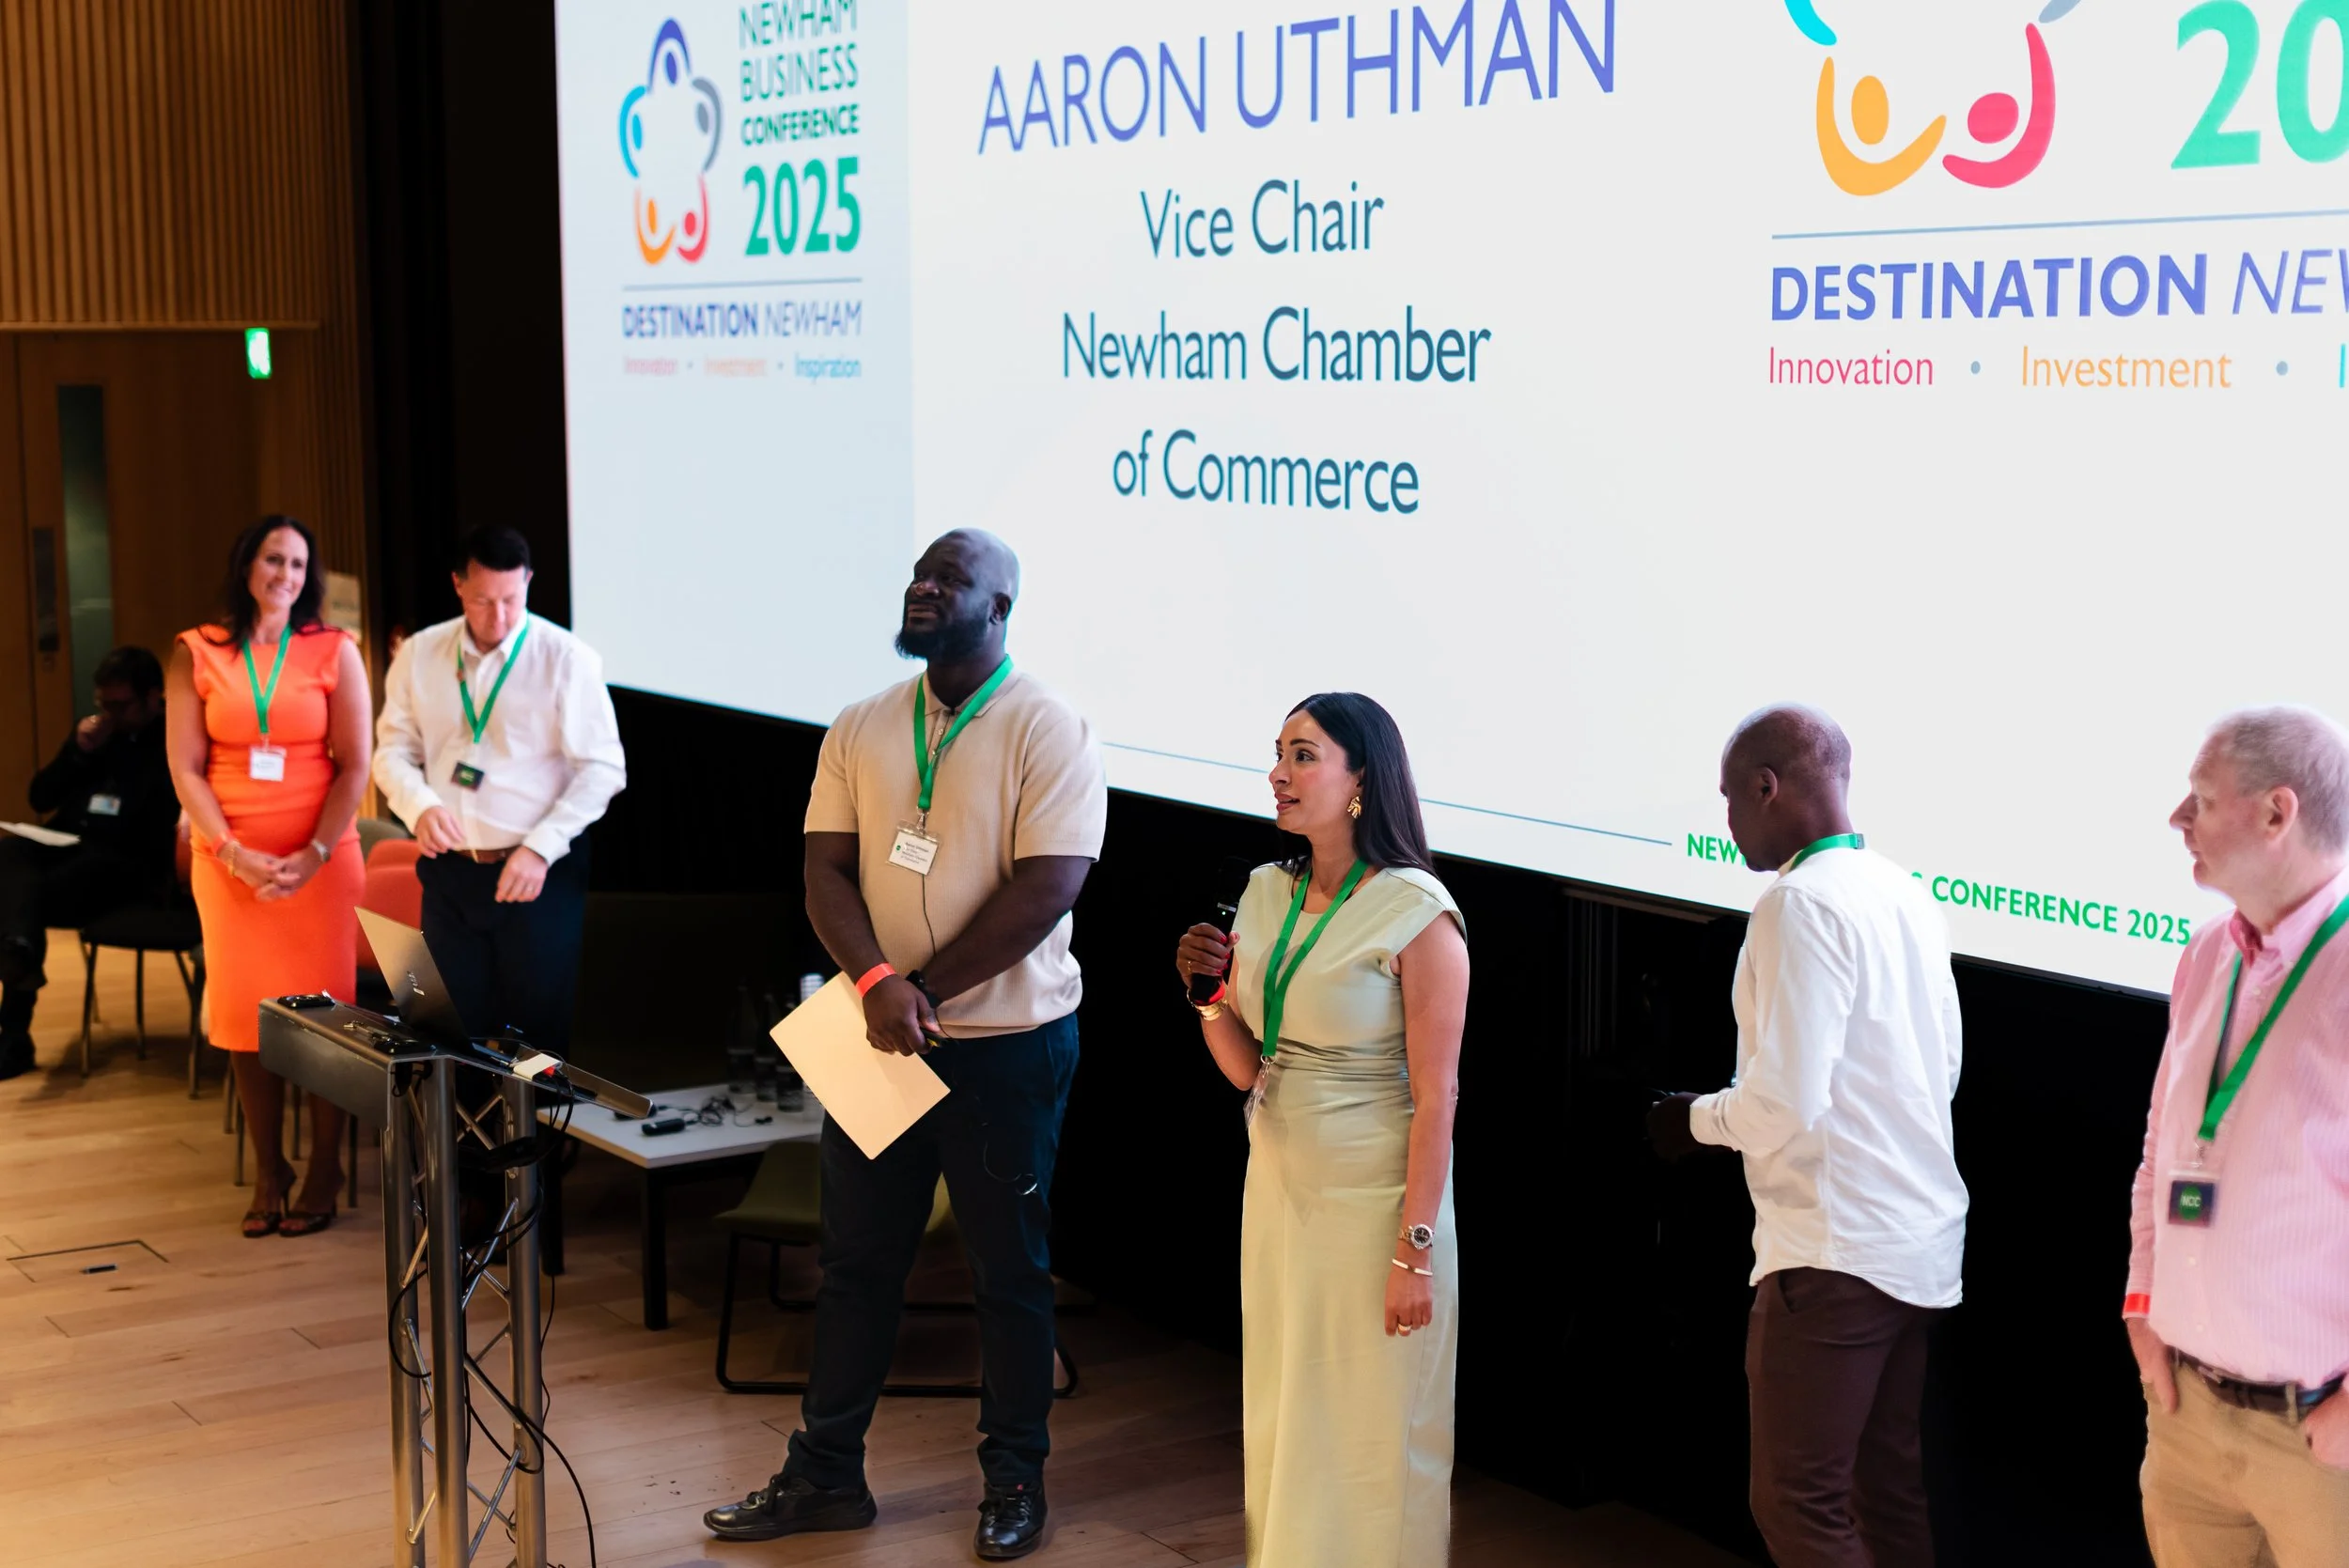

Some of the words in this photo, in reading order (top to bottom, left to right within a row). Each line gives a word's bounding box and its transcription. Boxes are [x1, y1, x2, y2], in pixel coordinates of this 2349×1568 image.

[739, 0, 857, 49] NEWHAM
[740, 42, 859, 102] BUSINESS
[977, 36, 1206, 156] AARON
[1236, 0, 1615, 130] UTHMAN
[741, 103, 859, 146] CONFERENCE
[743, 156, 861, 256] 2025
[1140, 188, 1234, 258] Vice
[1251, 179, 1385, 255] Chair
[623, 302, 758, 338] DESTINATION
[764, 300, 863, 338] NEWHAM
[1772, 254, 2207, 320] DESTINATION
[1063, 309, 1247, 380] Newham
[1262, 304, 1492, 383] Chamber
[1770, 347, 1933, 385] Innovation
[2022, 346, 2232, 388] Investment
[1112, 428, 1154, 497] of
[1162, 428, 1420, 515] Commerce
[1932, 876, 2119, 934] CONFERENCE
[2127, 908, 2191, 946] 2025
